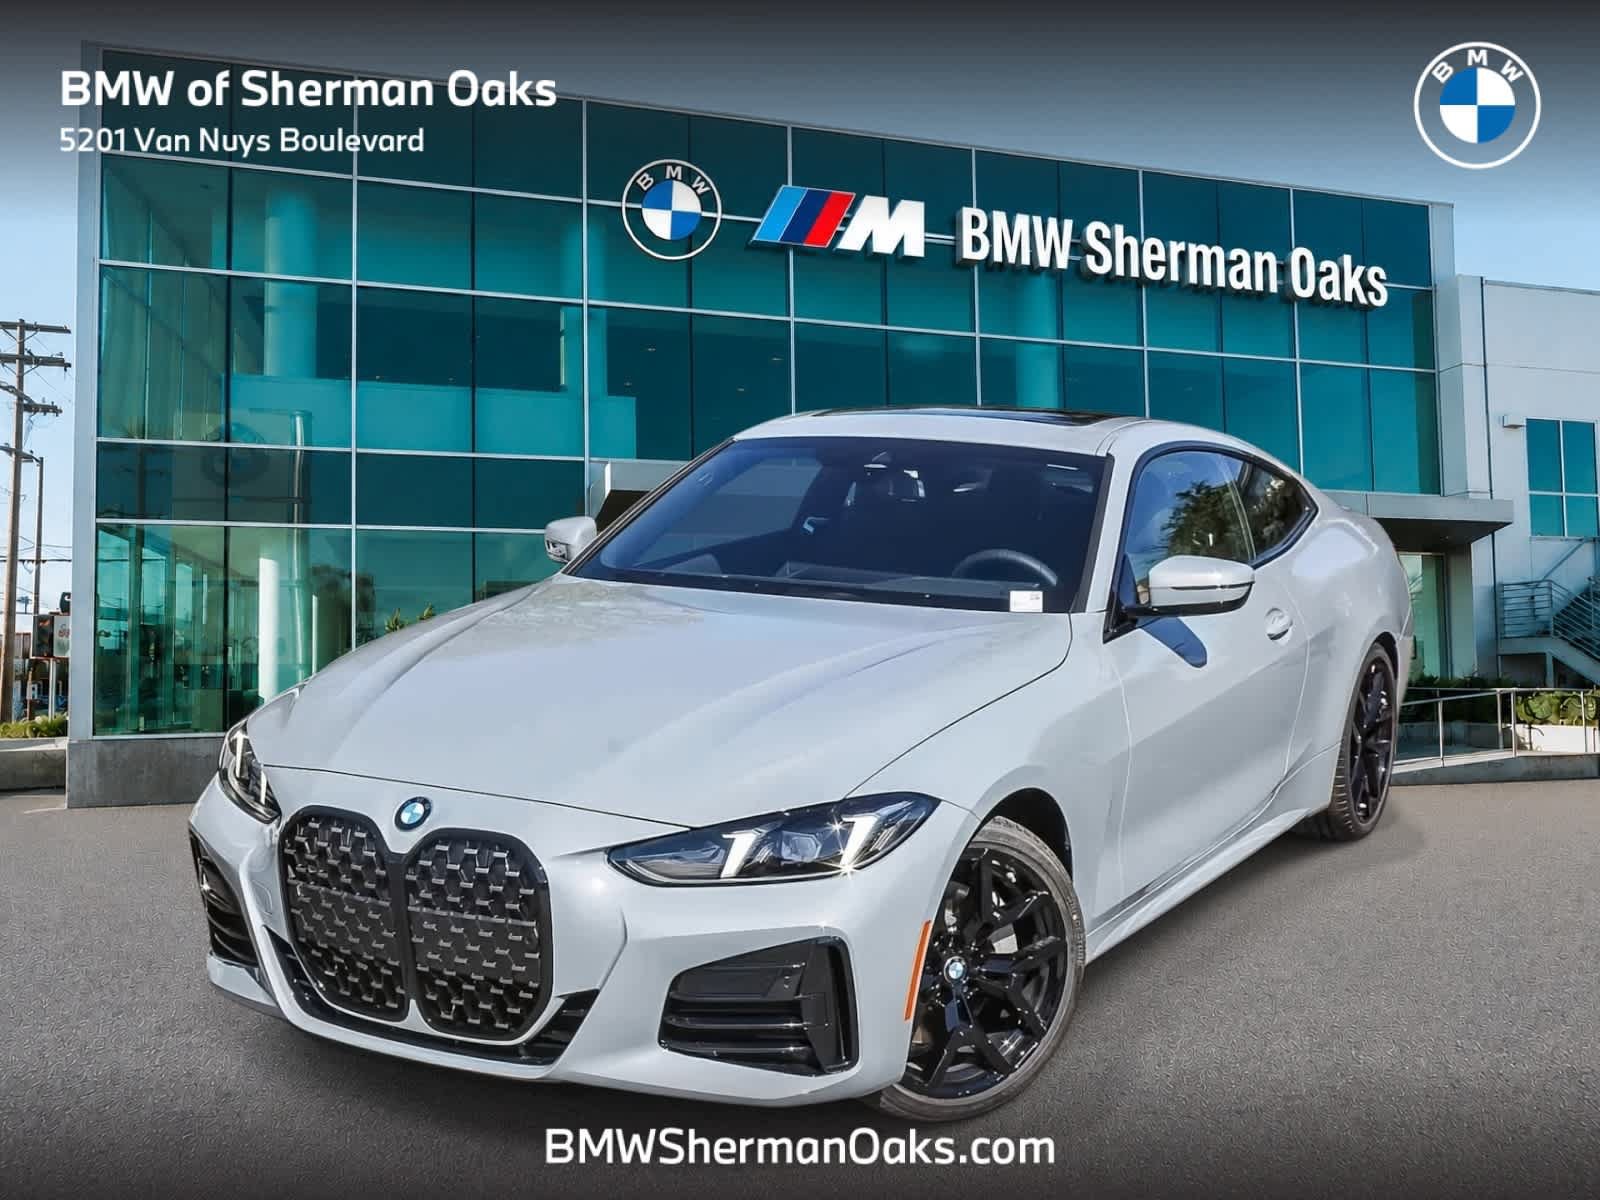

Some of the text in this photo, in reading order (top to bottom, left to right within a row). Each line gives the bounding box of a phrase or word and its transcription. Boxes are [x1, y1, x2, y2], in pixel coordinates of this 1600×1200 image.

[636, 165, 710, 199] BMW
[836, 194, 926, 258] M
[960, 206, 1389, 308] BMW Sherman Oaks
